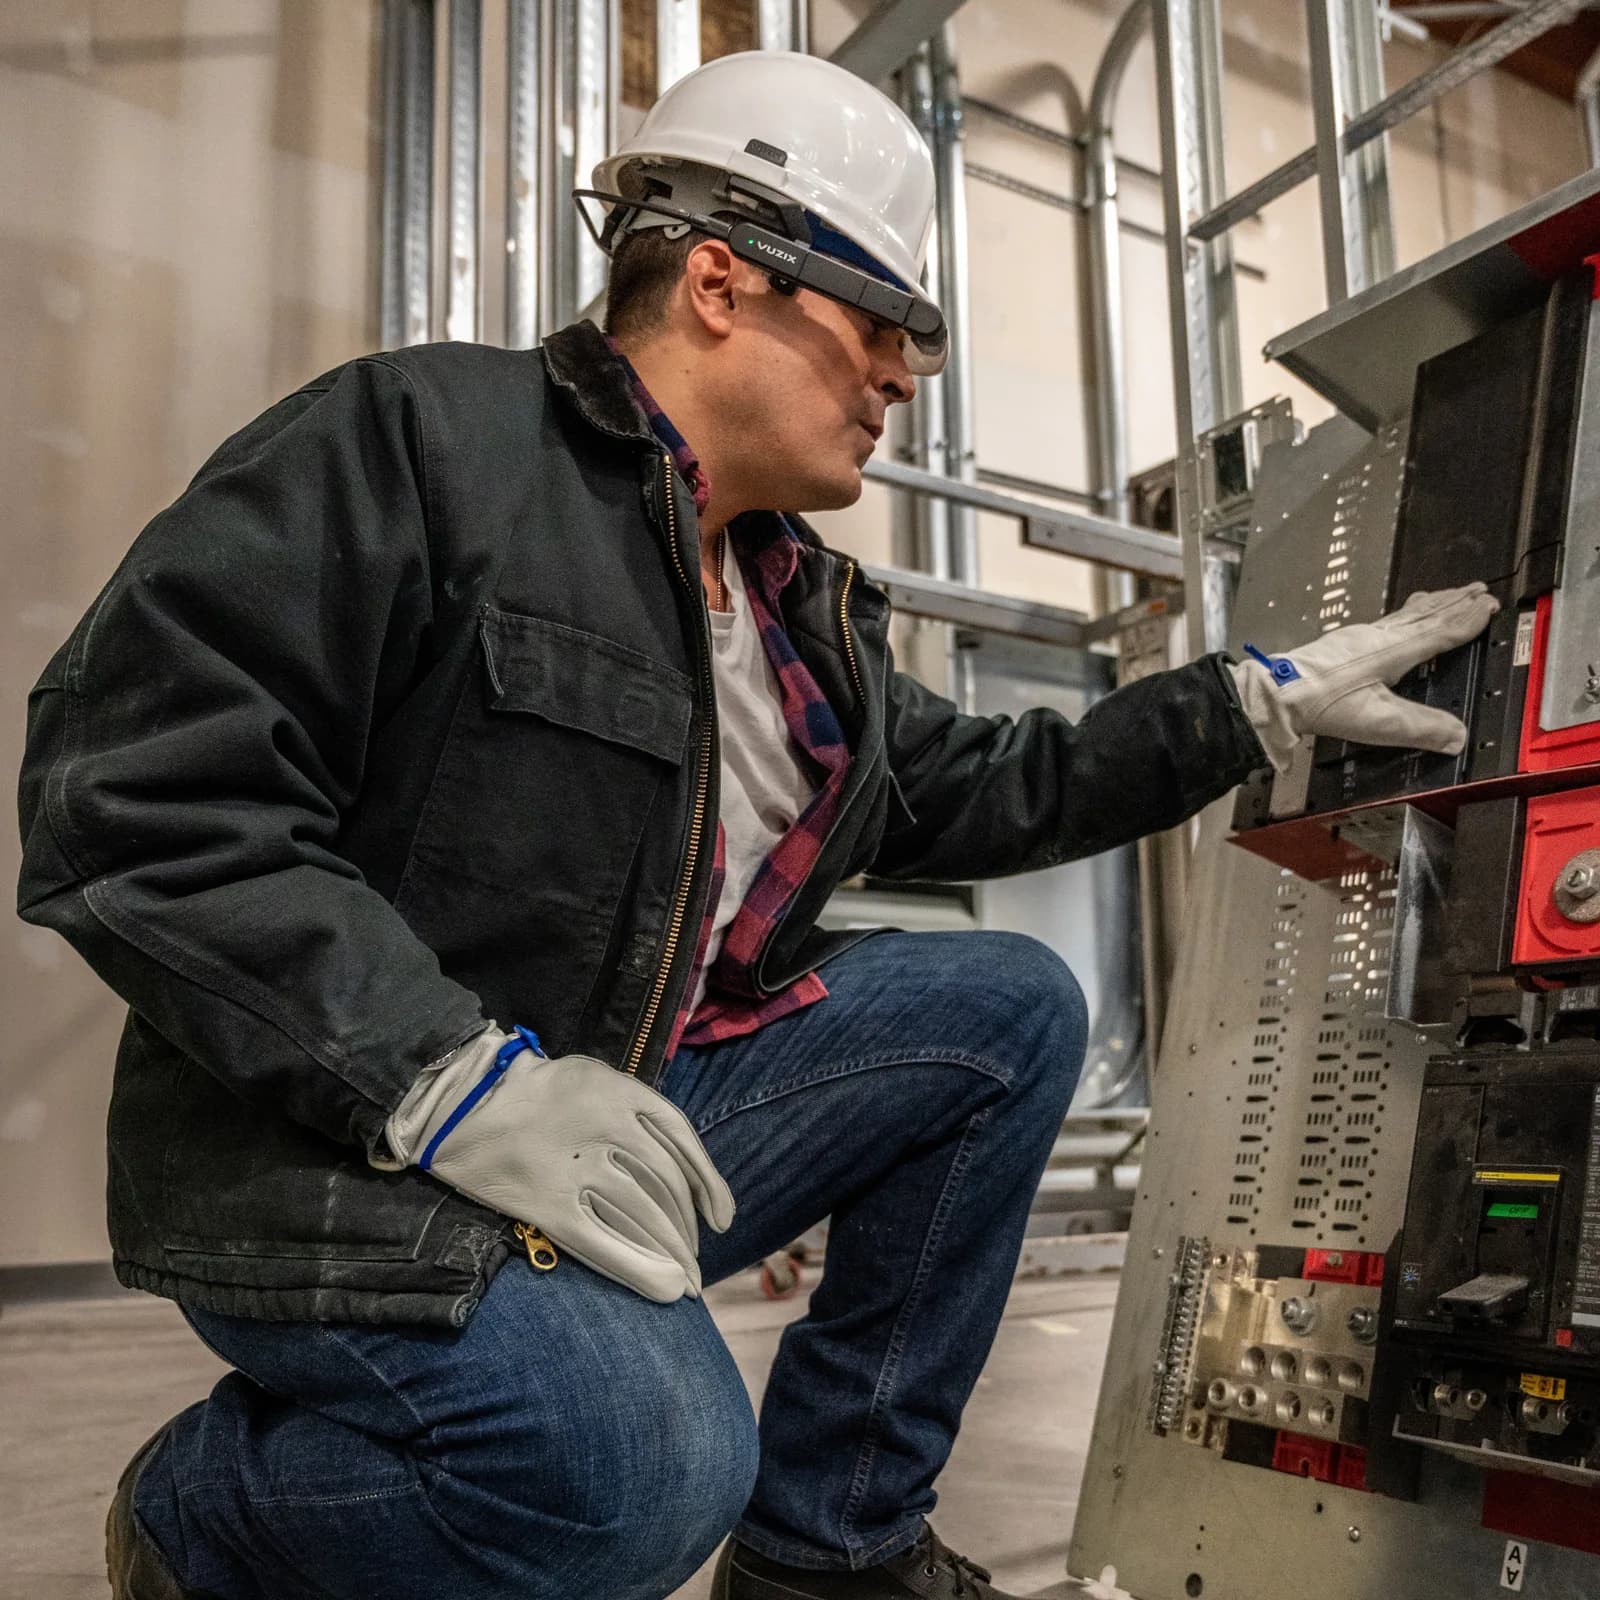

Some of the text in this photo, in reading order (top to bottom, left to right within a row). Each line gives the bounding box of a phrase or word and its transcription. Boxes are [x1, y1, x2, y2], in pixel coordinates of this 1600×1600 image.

[757, 241, 797, 263] VUZIX
[1508, 1206, 1529, 1214] OFF
[1508, 1545, 1521, 1563] A
